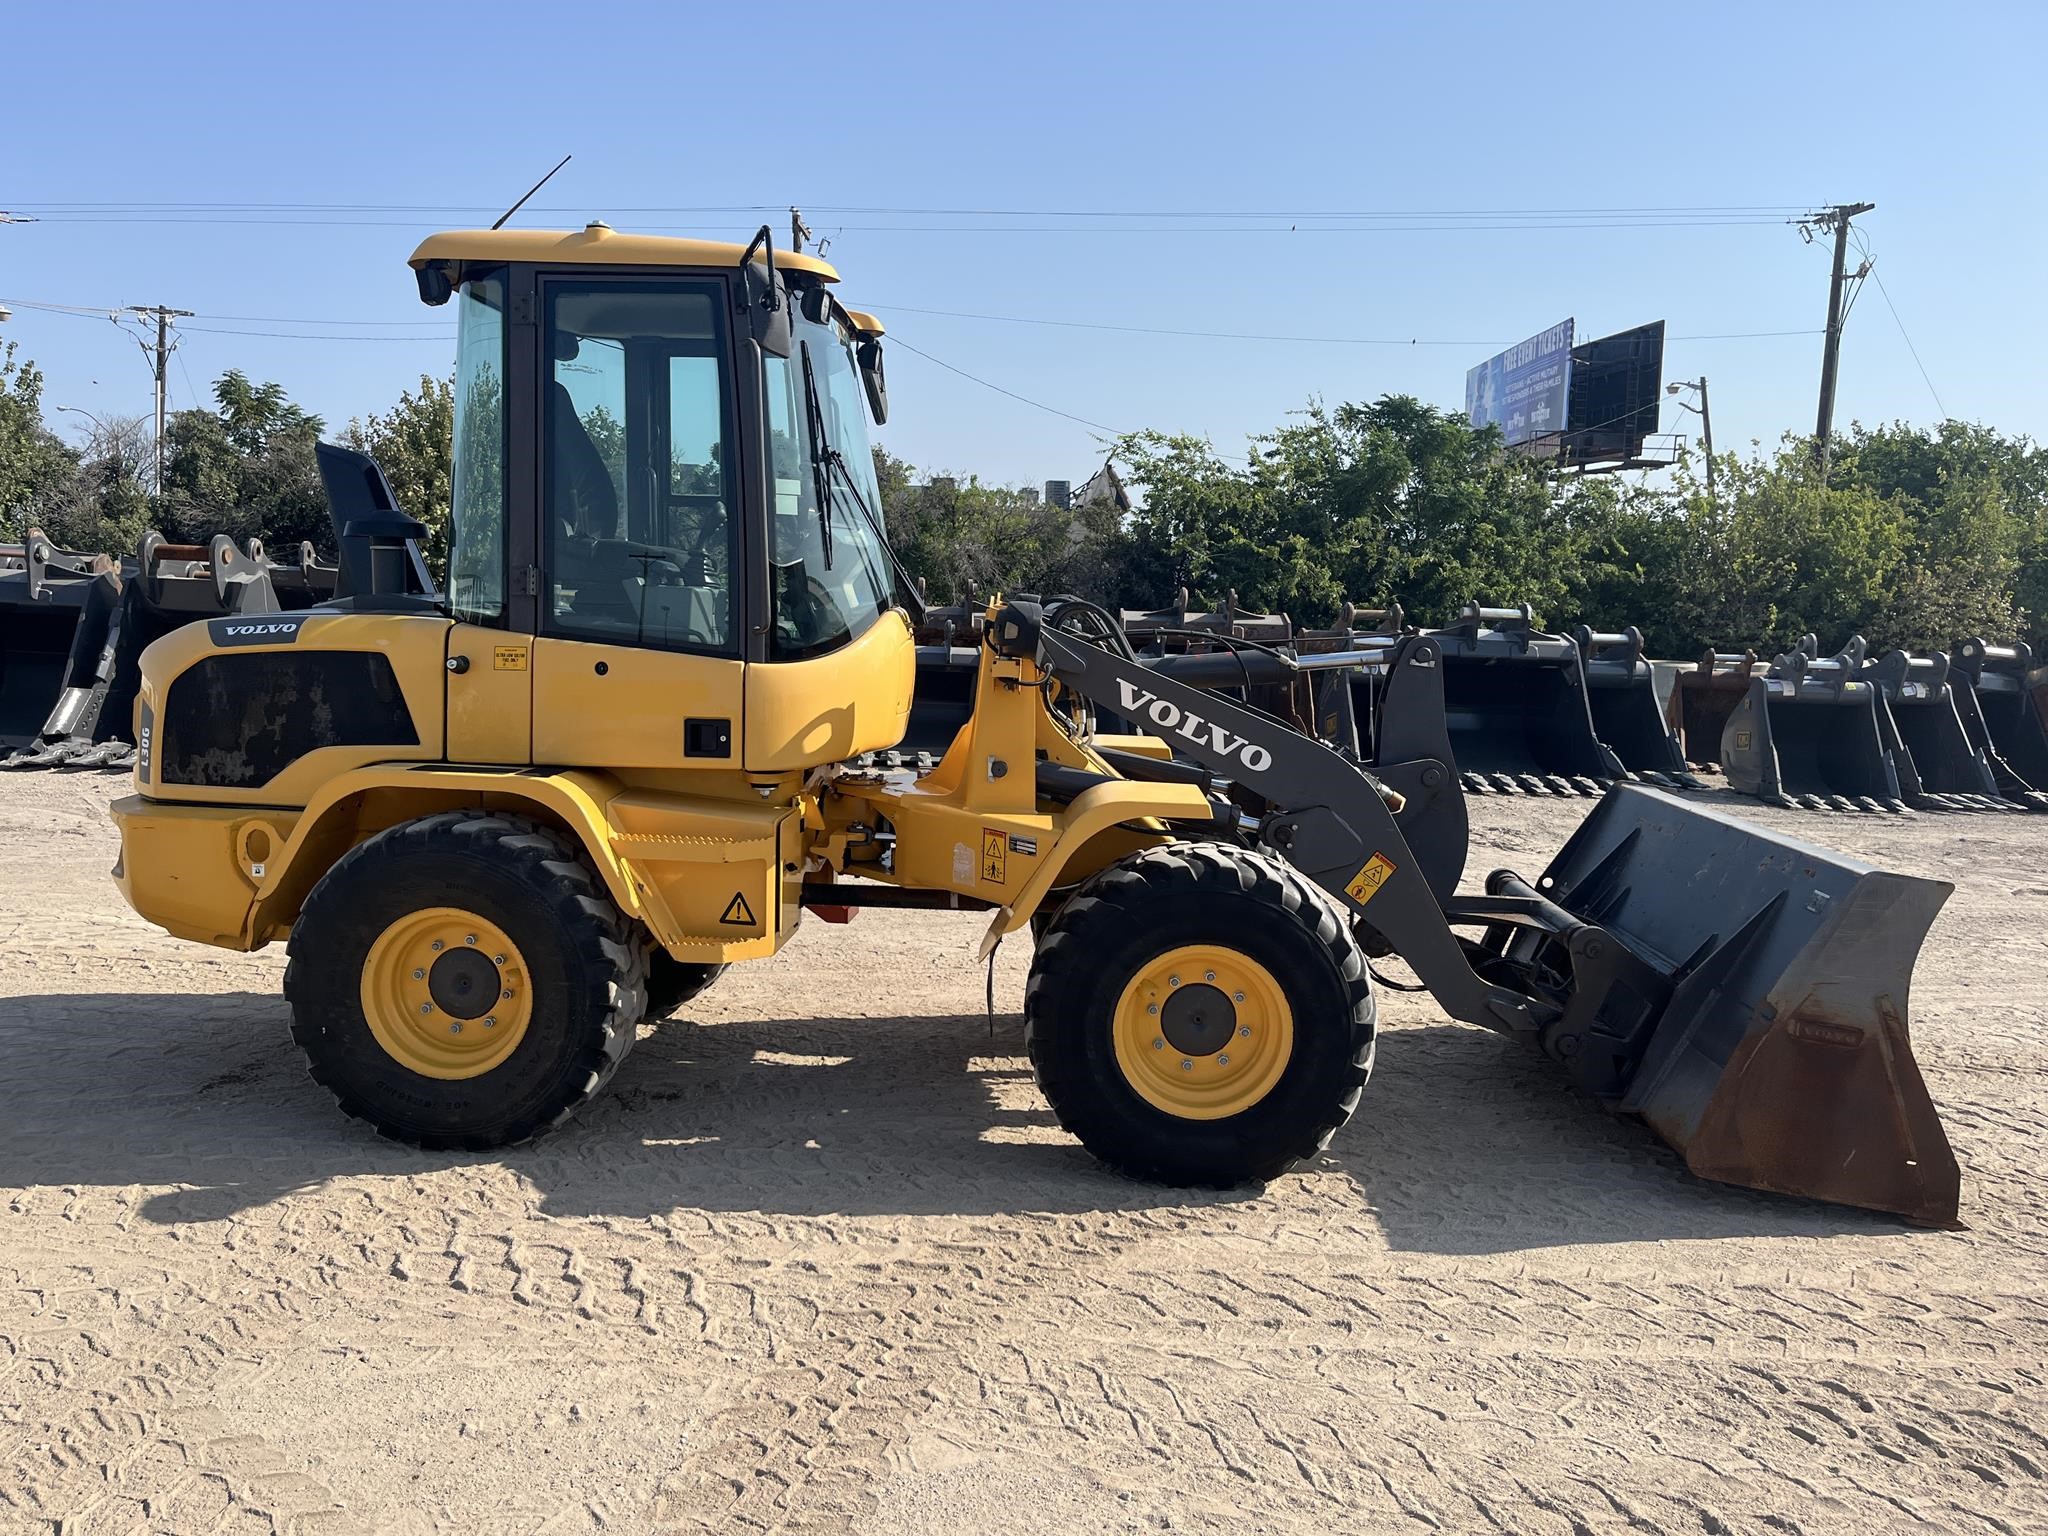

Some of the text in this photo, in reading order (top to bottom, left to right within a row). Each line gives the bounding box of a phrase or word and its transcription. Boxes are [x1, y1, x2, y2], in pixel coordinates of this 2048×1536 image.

[1504, 323, 1565, 373] FREE EVENT TICKETS
[225, 623, 297, 636] VOLVO
[141, 727, 150, 767] L30G
[1116, 677, 1272, 772] VOLVO
